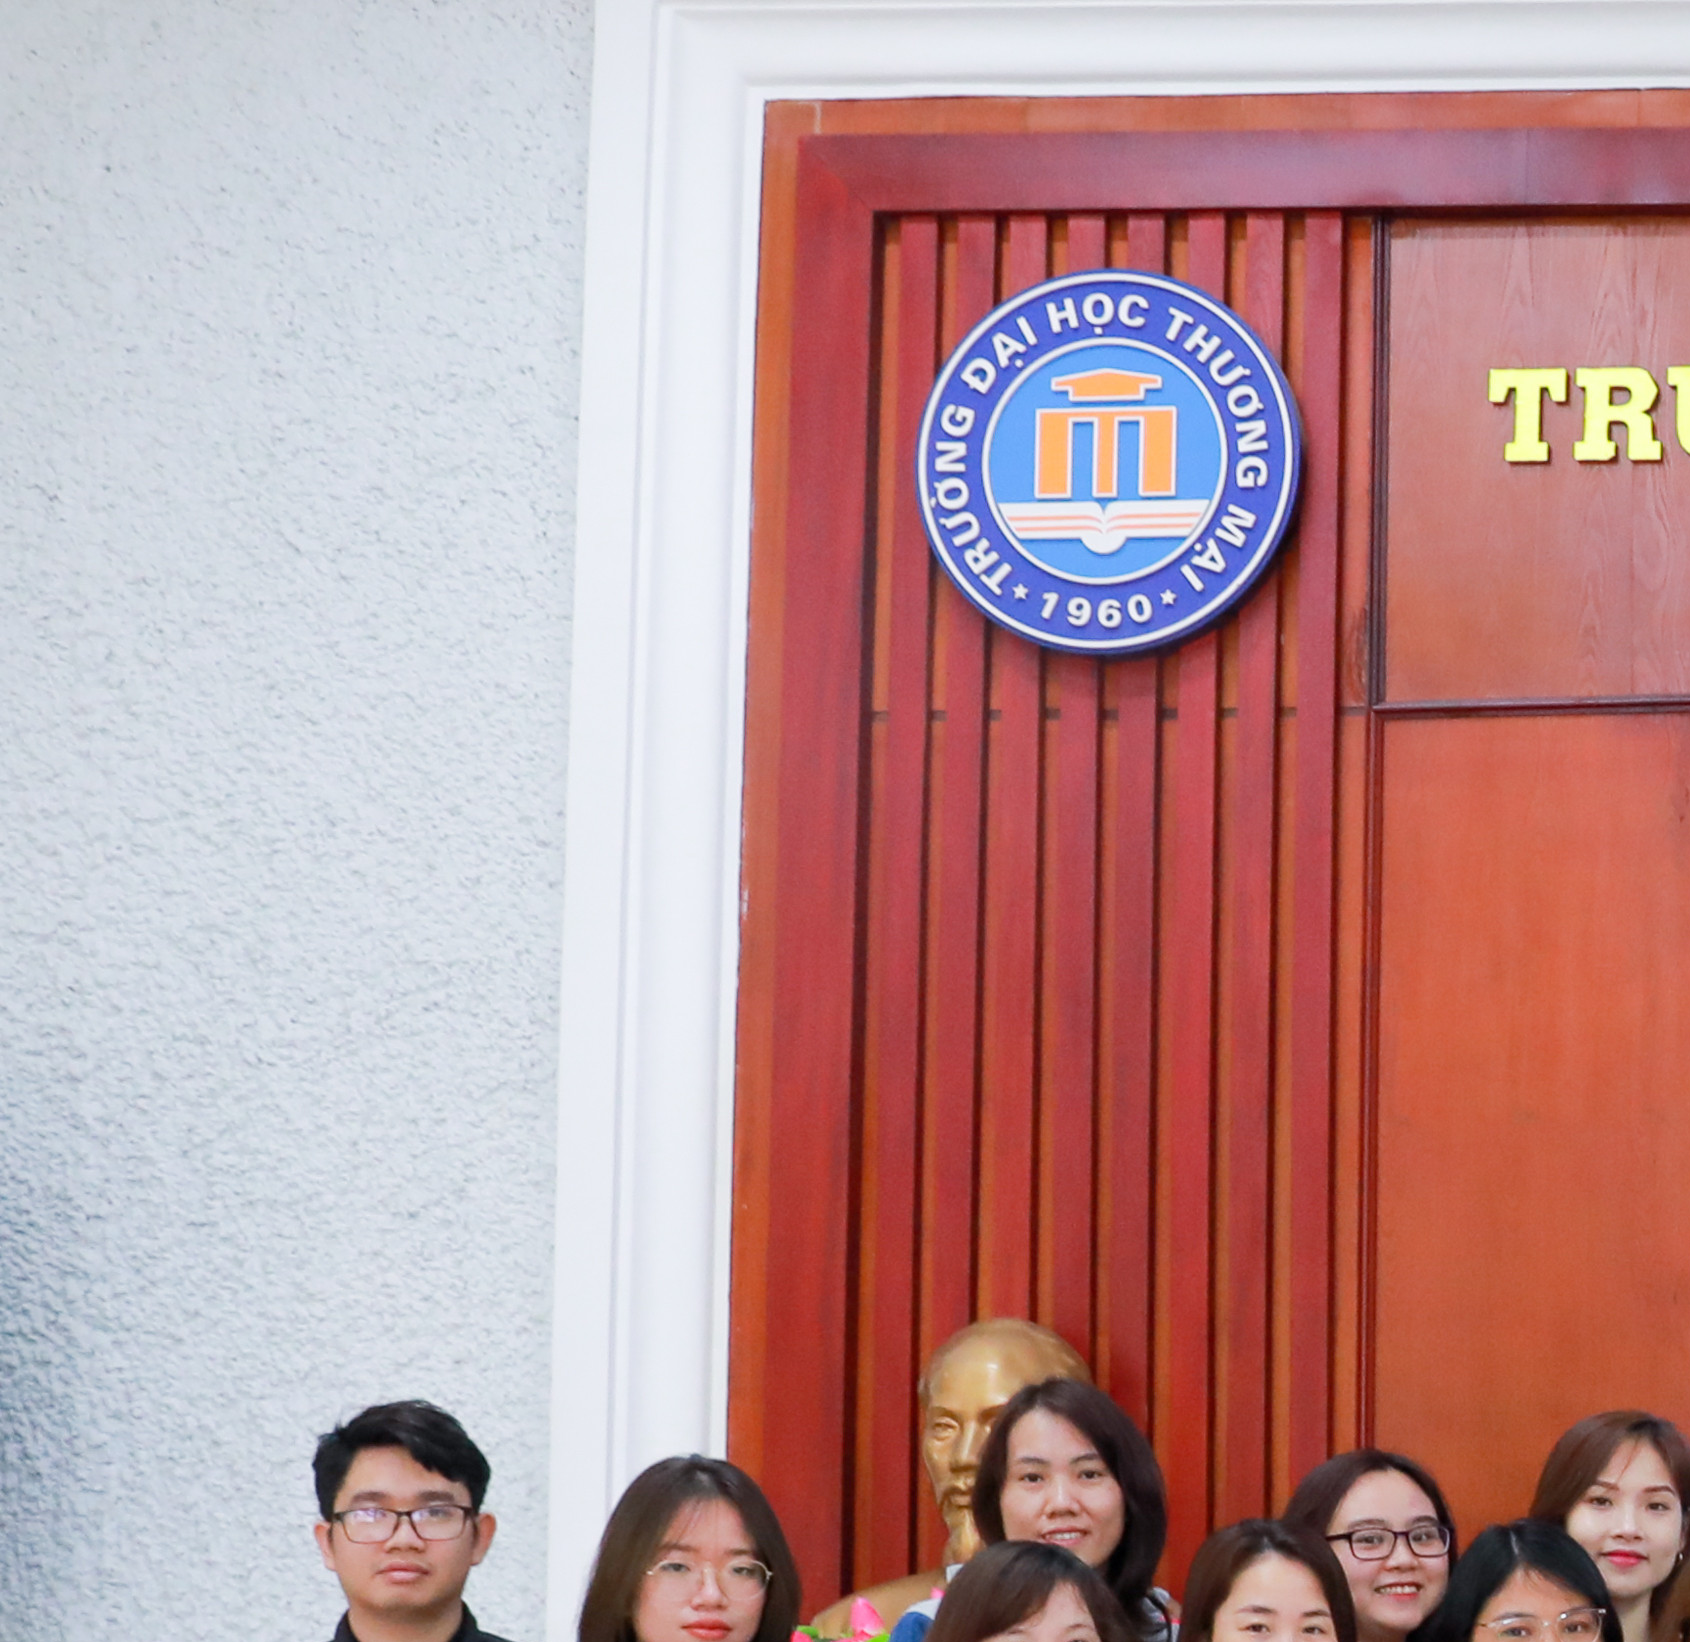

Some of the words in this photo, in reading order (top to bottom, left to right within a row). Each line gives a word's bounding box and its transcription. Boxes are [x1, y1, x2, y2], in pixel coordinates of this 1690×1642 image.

[960, 315, 1038, 395] ĐẠI
[1046, 292, 1150, 335] HỌC
[1165, 306, 1269, 490] THƯƠNG
[930, 404, 1012, 597] TRƯỜNG
[1180, 502, 1257, 592] MẠI
[1040, 591, 1153, 629] 1960
